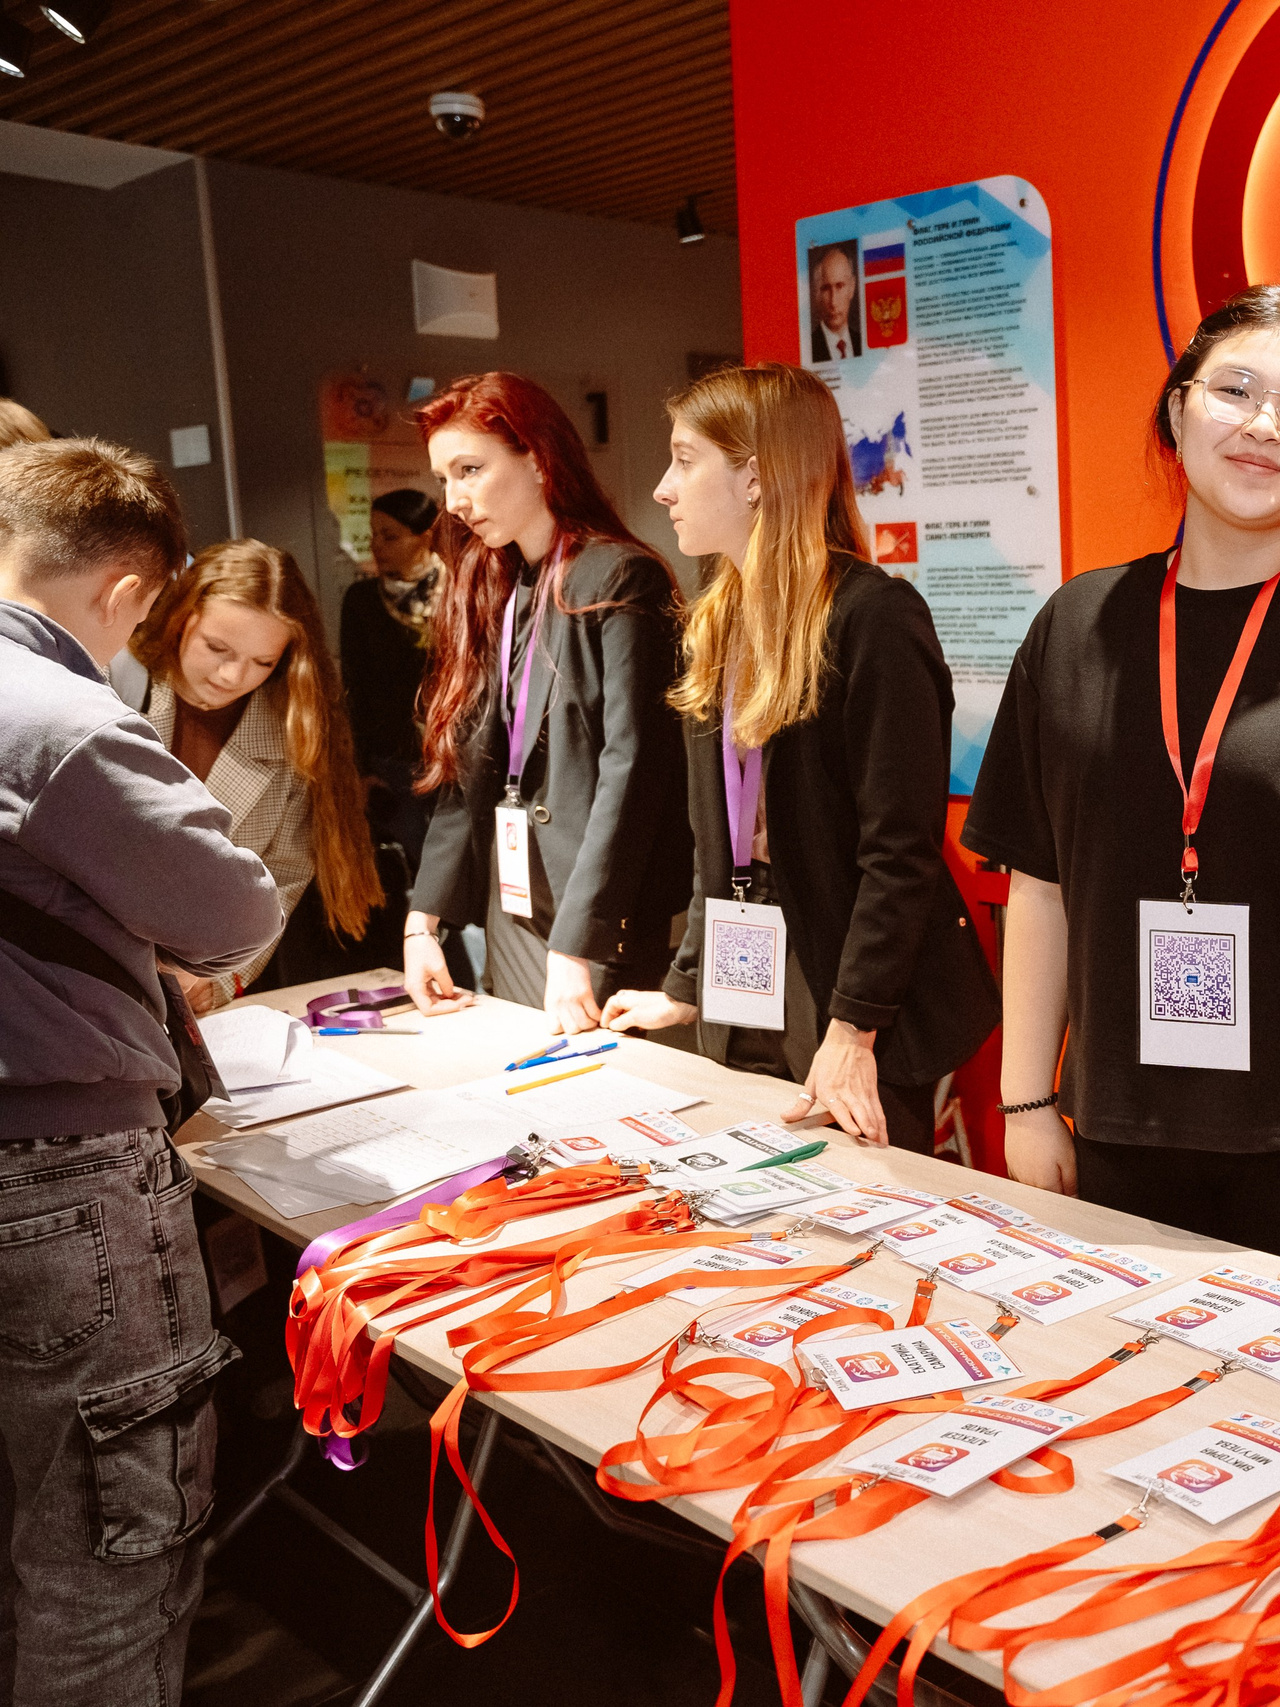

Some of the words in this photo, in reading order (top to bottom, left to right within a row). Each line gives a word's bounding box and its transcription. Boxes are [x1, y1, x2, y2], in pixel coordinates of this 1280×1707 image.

[1004, 1229, 1066, 1257] КИНОМАСТЕРСКАЯ
[1053, 1274, 1088, 1290] ГЕОРГИЙ
[1067, 1268, 1104, 1285] СЕМЕНОВ
[1076, 1256, 1143, 1285] КИНОМАСТЕРСКАЯ
[1189, 1297, 1234, 1313] СЕРАФИМ
[1204, 1291, 1246, 1308] ПАНИХИН
[891, 1343, 926, 1374] ЕКАТЕРИНА
[911, 1340, 946, 1370] САМАРИНА
[934, 1327, 984, 1379] КИНОМАСТЕРСКАЯ
[813, 1353, 850, 1393] САНКТ-ПЕТЕРБУРГ
[960, 1423, 1003, 1438] УРАКОВ
[961, 1408, 1053, 1432] КИНОМАСТЕРСКАЯ
[940, 1431, 990, 1447] АЛЕКСЕЙ
[1200, 1447, 1255, 1473] ВИКТОРИЯ
[1214, 1440, 1274, 1466] МИГУЛЕВА
